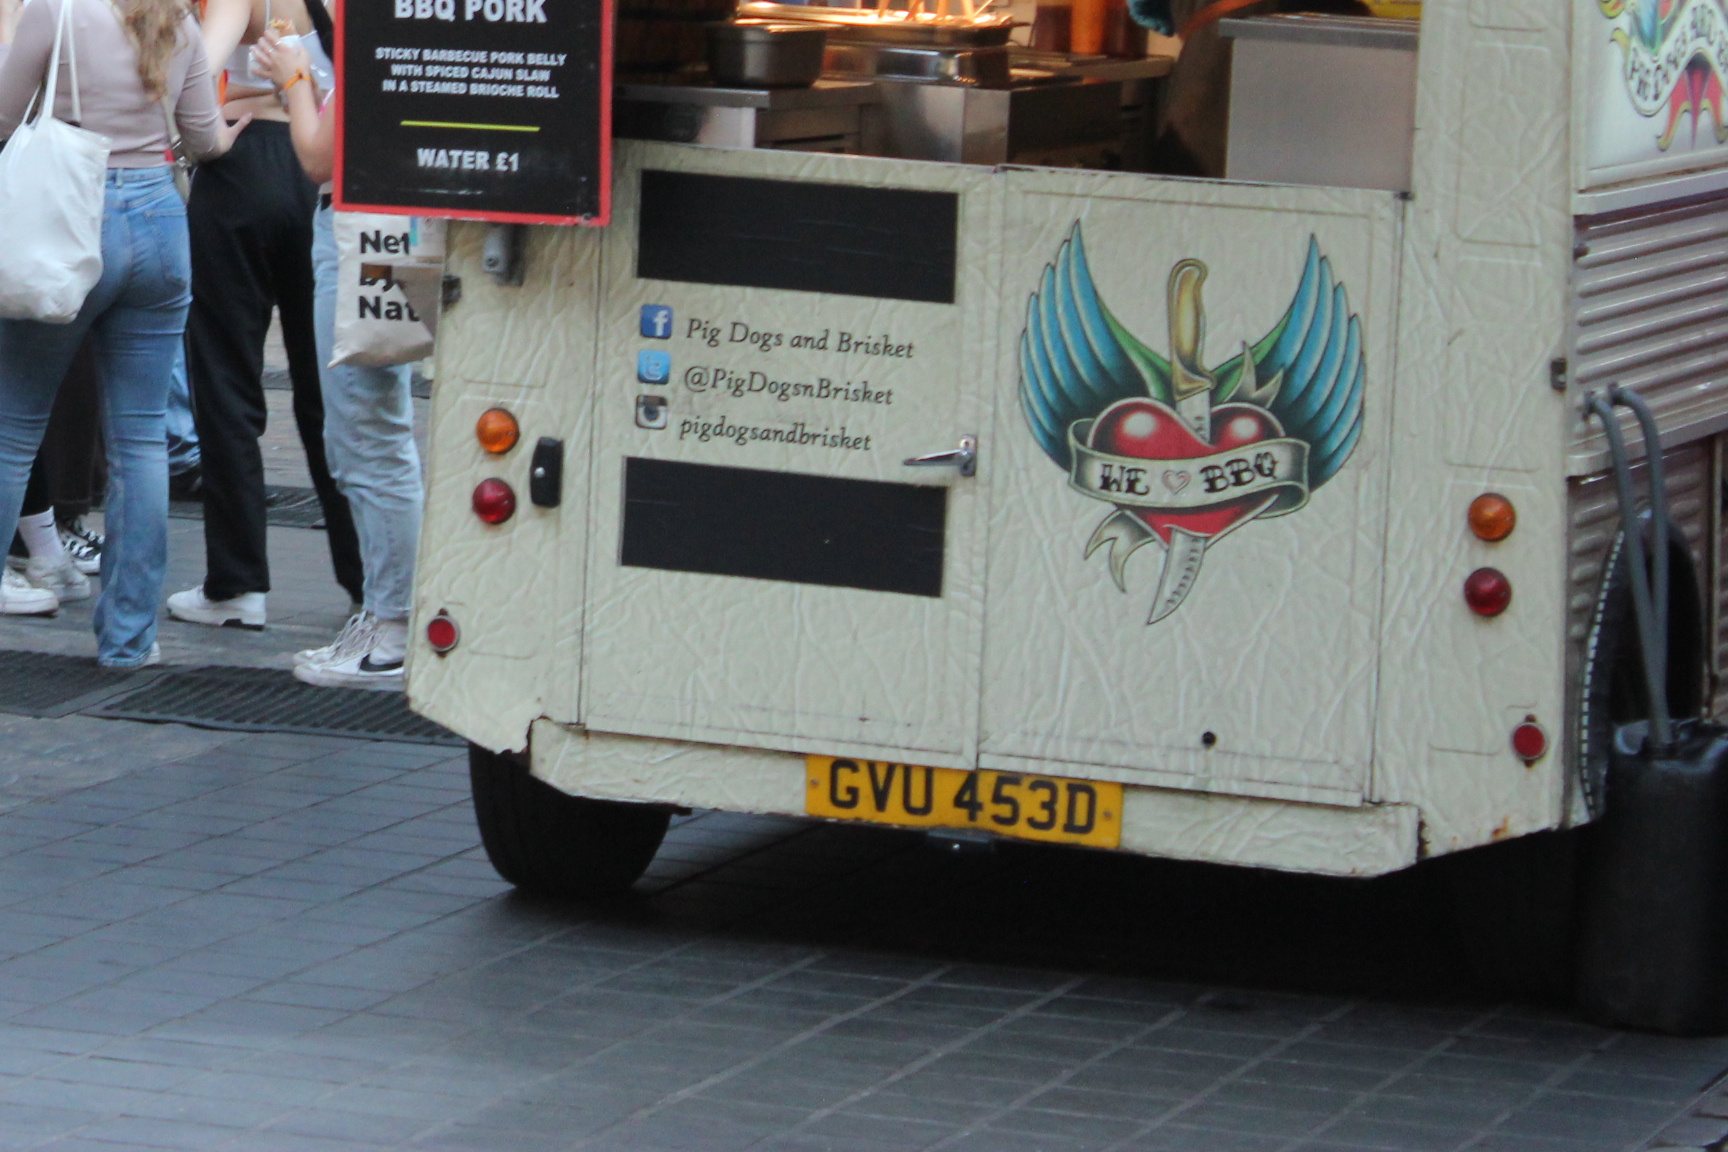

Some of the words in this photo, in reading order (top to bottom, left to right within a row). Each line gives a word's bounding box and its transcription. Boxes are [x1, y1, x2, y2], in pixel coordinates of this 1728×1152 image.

[375, 47, 421, 61] STICKY
[422, 48, 488, 63] BARBECUE
[490, 51, 525, 65] PORK
[526, 53, 567, 66] BELLY
[390, 63, 423, 76] WITH
[424, 65, 470, 79] SPICED
[471, 66, 514, 80] CAJUN
[515, 68, 551, 81] SLAW
[382, 79, 397, 91] IN
[398, 80, 409, 92] A
[410, 81, 467, 94] STEAMED
[469, 83, 525, 97] BRIOCHE
[526, 85, 560, 98] ROLL
[417, 148, 489, 171] WATER
[495, 151, 520, 172] £1
[686, 318, 721, 347] Pig
[729, 322, 783, 352] Dogs
[790, 329, 829, 350] and
[836, 332, 916, 359] Brisket
[684, 365, 894, 405] @PigDogsnBrisket
[679, 415, 872, 451] pigdogsandbrisket
[1099, 463, 1150, 496] WE
[1200, 452, 1279, 493] BBQ
[829, 759, 934, 816] GVU
[953, 770, 1097, 835] 453D
